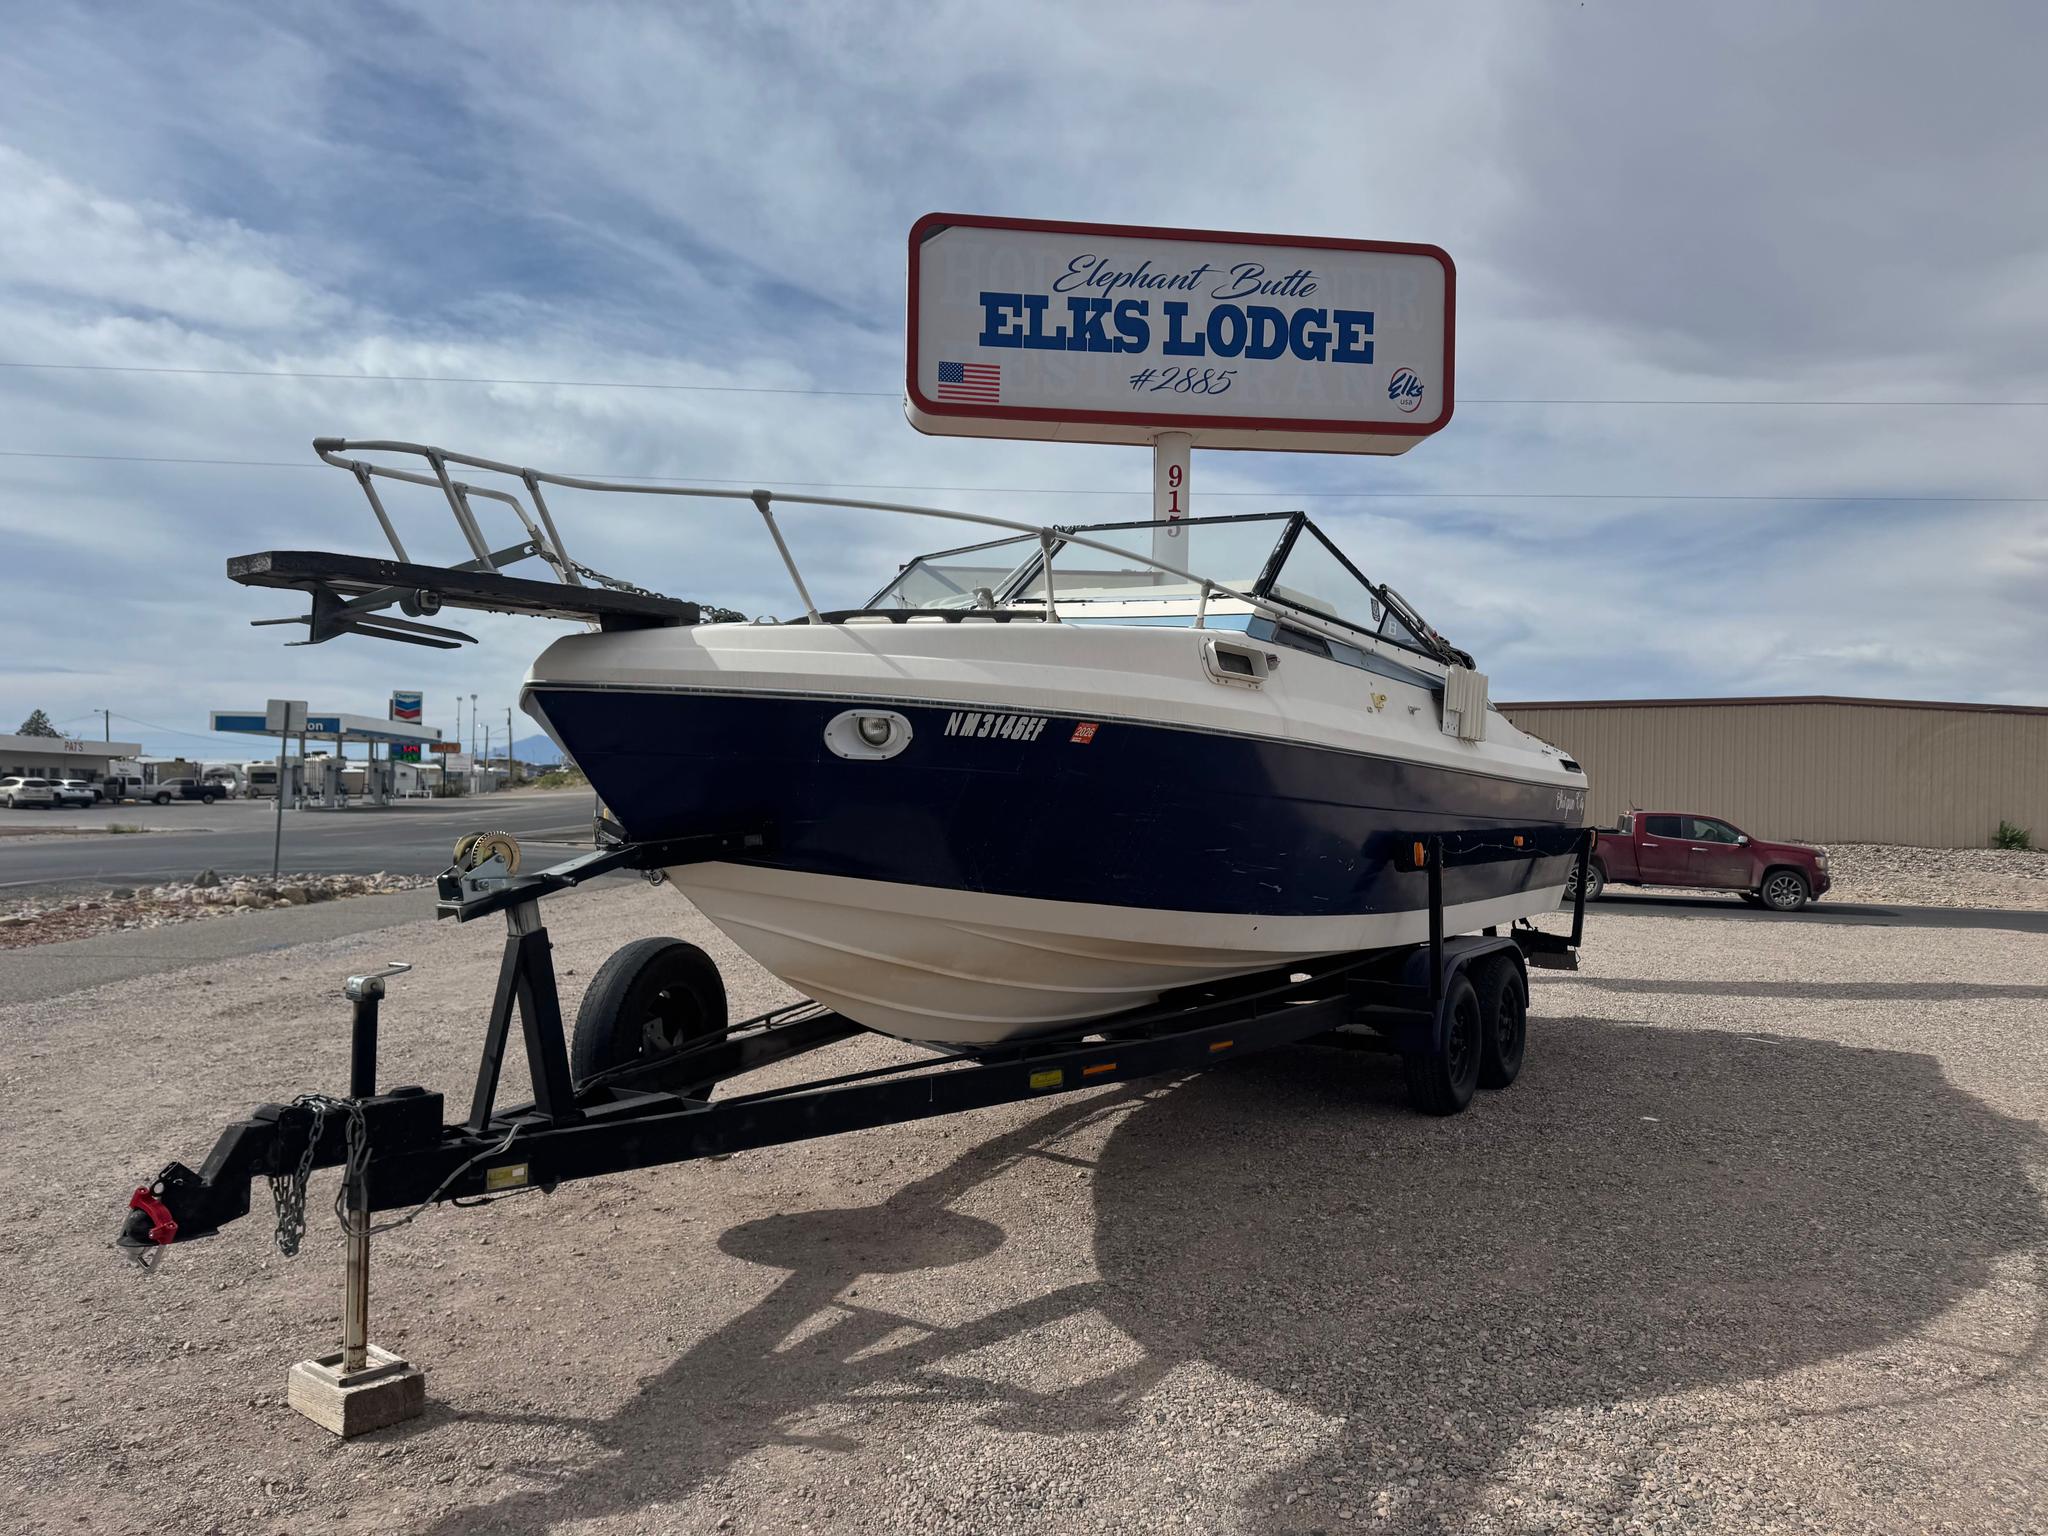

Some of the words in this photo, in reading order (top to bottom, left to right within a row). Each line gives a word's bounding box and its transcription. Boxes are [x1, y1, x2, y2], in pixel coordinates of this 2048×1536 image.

[1053, 254, 1222, 298] Elephant
[1211, 262, 1320, 300] Butte
[979, 291, 1151, 354] ELKS
[1162, 301, 1374, 365] LODGE
[1129, 367, 1238, 396] #2885
[1388, 373, 1424, 399] Elks
[1167, 464, 1183, 538] 915
[944, 712, 1048, 742] NM3146EF
[1074, 726, 1095, 737] 2026
